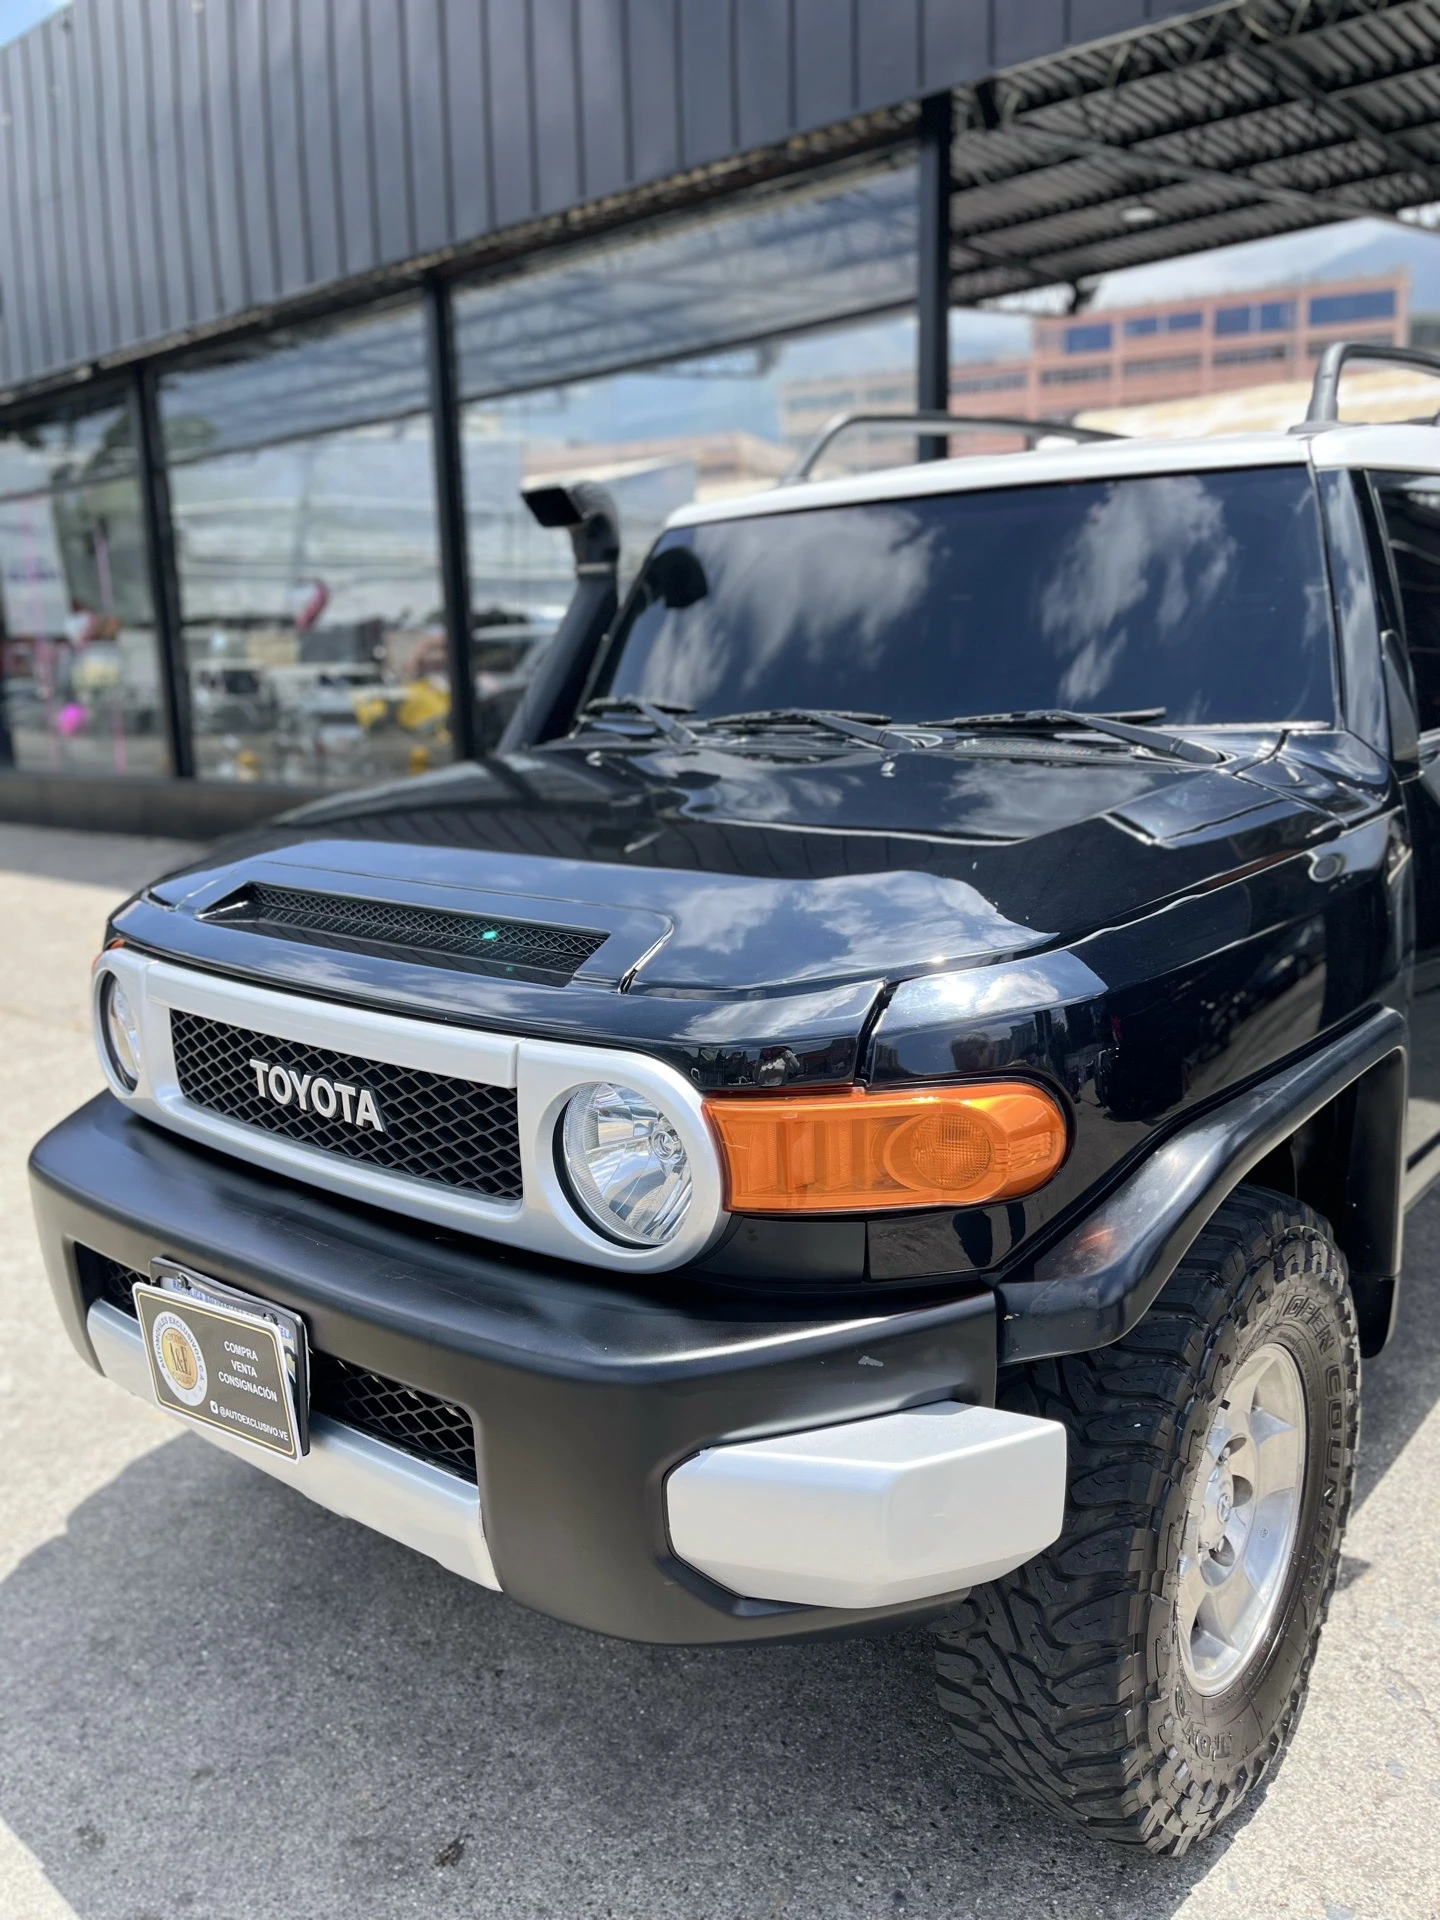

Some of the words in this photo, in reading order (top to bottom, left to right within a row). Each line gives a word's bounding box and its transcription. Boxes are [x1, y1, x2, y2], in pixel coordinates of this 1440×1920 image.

[249, 1057, 386, 1132] TOYOTA
[168, 1316, 202, 1360] EXCLUSIVOS
[1283, 1295, 1336, 1356] OPEN
[224, 1340, 259, 1362] COMPRA
[231, 1360, 258, 1378] VENTA
[218, 1371, 278, 1403] CONSIGNACIÓN
[219, 1407, 290, 1441] @AUTOEXCLUSIVO.VE
[1301, 1364, 1343, 1631] COUNTRY
